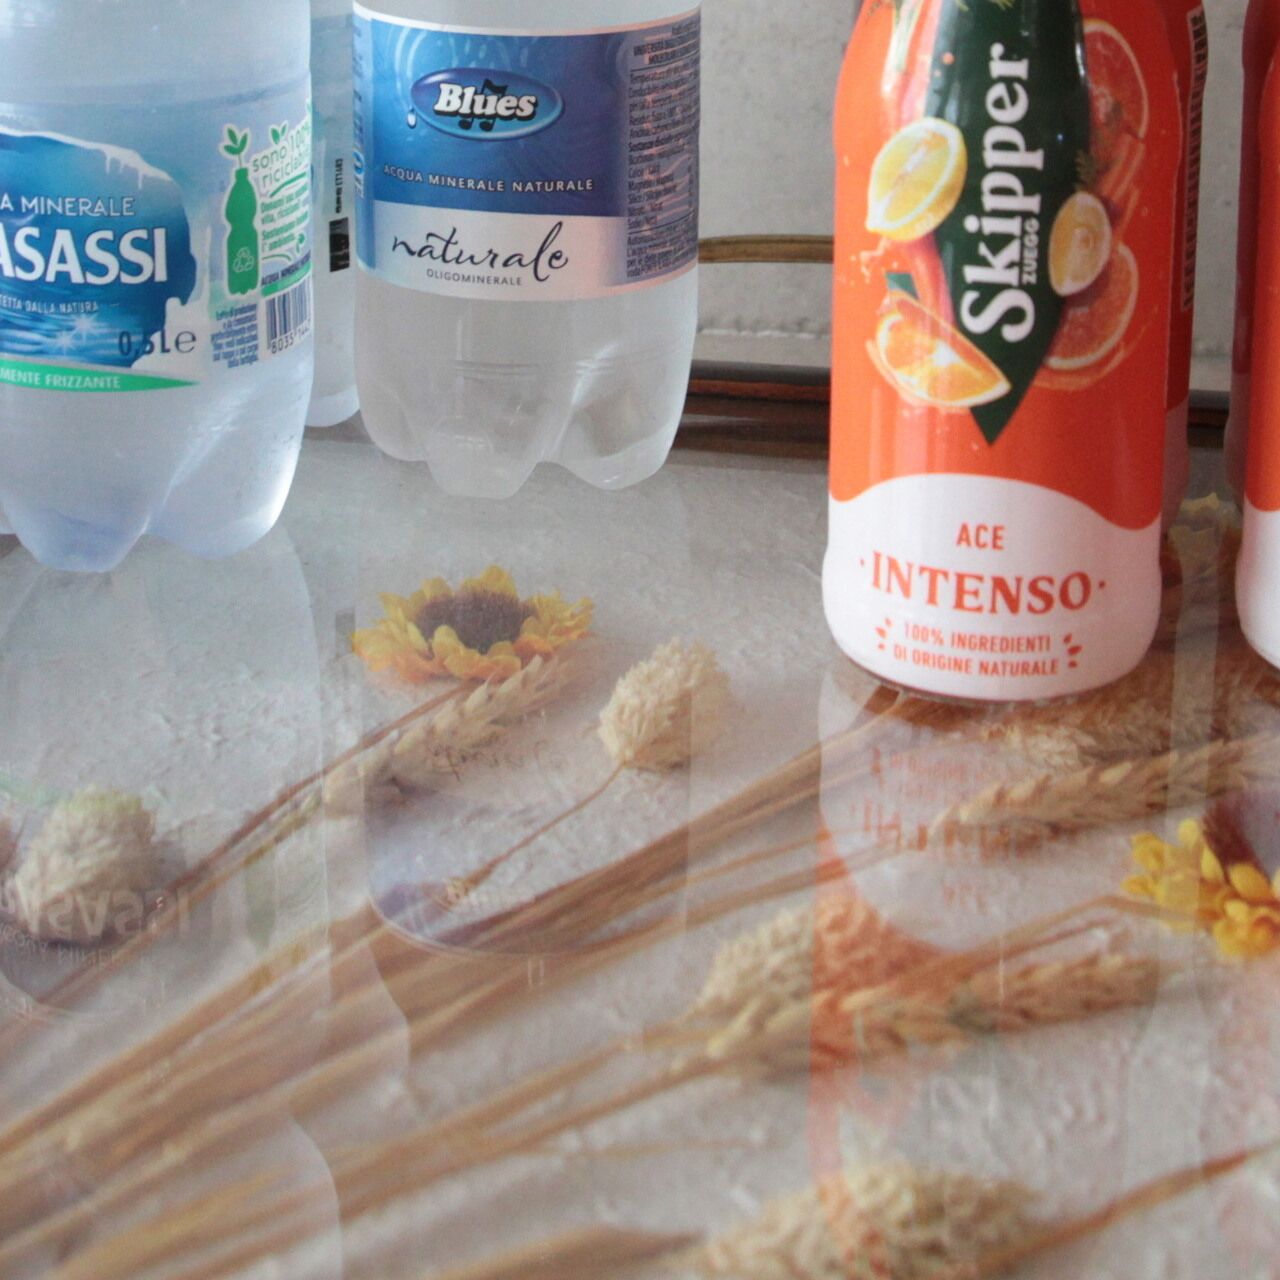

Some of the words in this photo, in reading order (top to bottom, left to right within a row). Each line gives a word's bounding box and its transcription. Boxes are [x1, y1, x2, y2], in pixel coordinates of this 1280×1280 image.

[433, 83, 537, 120] Blues
[252, 145, 288, 173] sono
[384, 165, 423, 182] ACQUA
[428, 174, 505, 192] MINERALE
[512, 179, 594, 193] NATURALE
[960, 42, 1045, 344] Skipper
[21, 196, 136, 218] MINERALE
[392, 221, 569, 282] naturale
[1022, 218, 1040, 285] ZUEGG
[426, 268, 523, 287] OLIGOMINERALE
[25, 299, 55, 315] DALLA
[59, 300, 99, 314] NATURA
[45, 373, 120, 389] FRIZZANTE
[956, 522, 1006, 551] ACE
[872, 549, 1092, 616] INTENSO
[904, 622, 945, 647] 100%
[951, 631, 1051, 654] INGREDIENTI
[893, 642, 908, 662] DI
[912, 650, 972, 675] ORIGINE
[978, 658, 1060, 677] NATURALE
